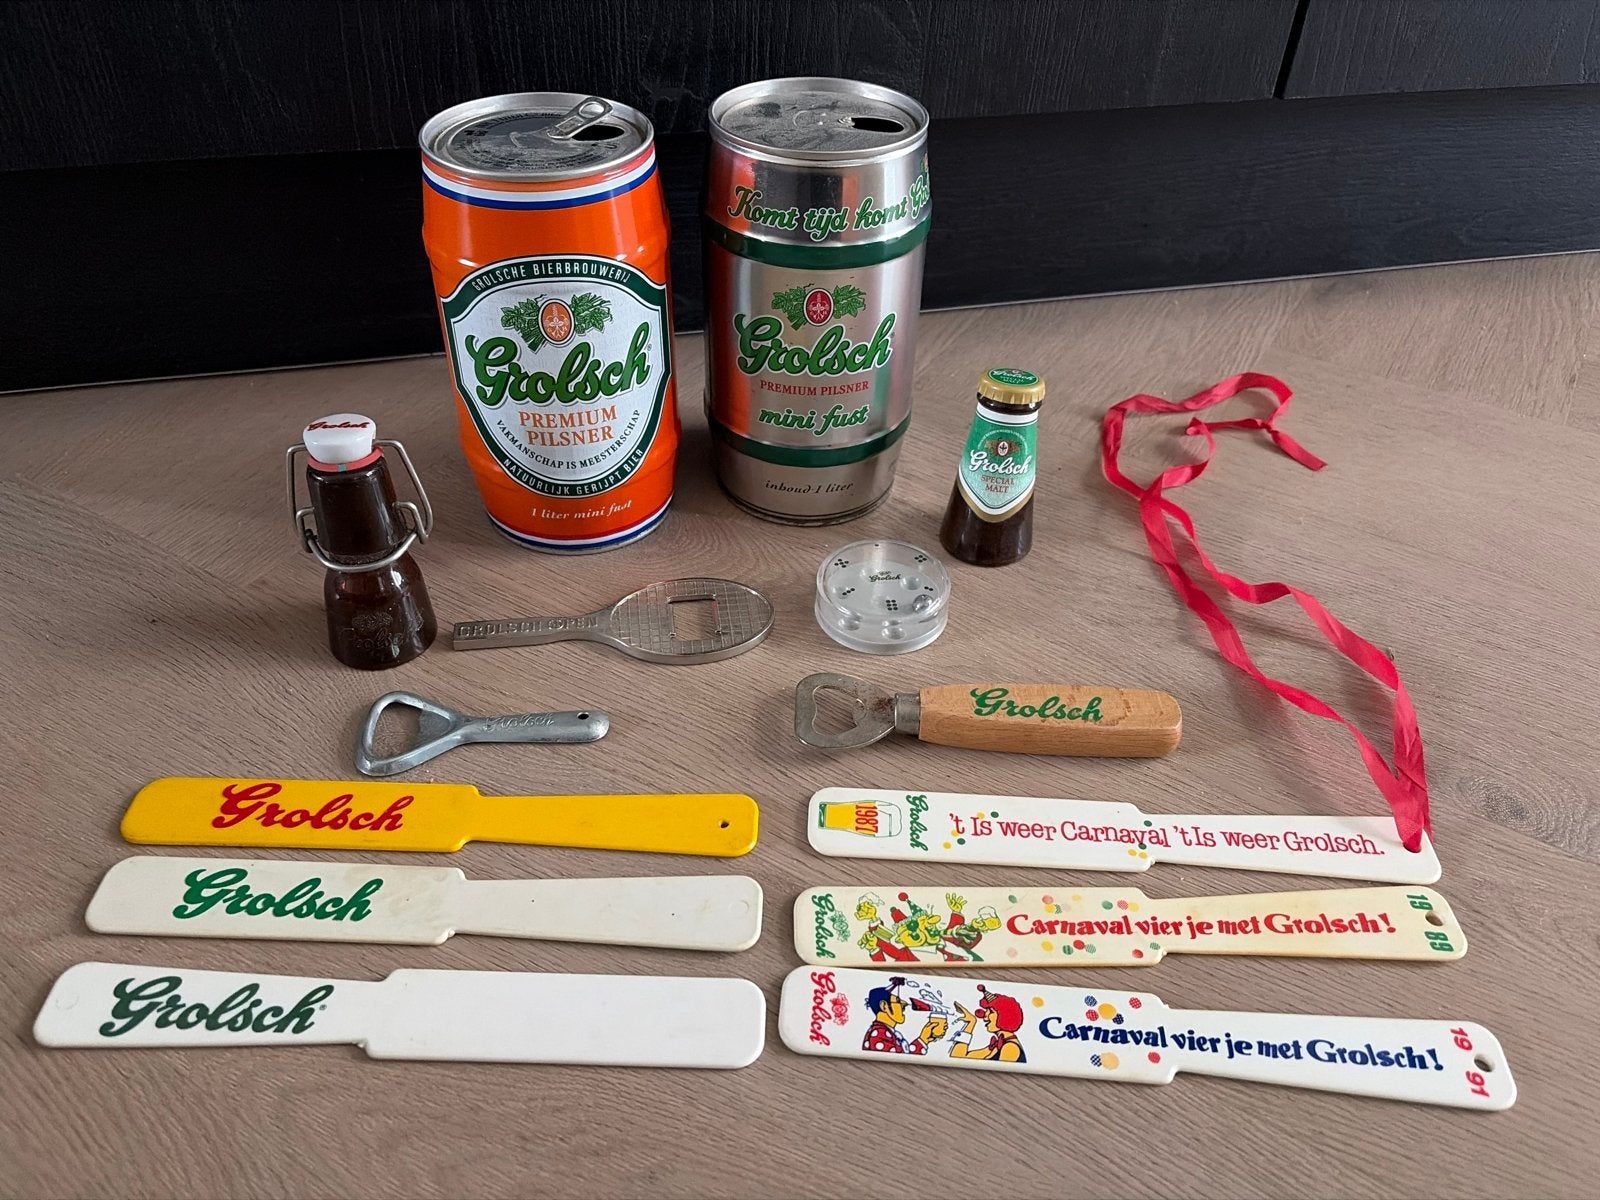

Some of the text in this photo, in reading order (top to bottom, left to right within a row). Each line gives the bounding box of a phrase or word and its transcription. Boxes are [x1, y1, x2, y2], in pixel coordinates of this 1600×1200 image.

[727, 185, 799, 230] Komt
[803, 207, 850, 241] tijd
[853, 197, 908, 231] komt
[472, 262, 631, 291] GROLSCHE BIERBROUWERIJ
[734, 312, 896, 376] Grolsch
[465, 321, 650, 406] Grolsch
[760, 379, 870, 396] PREMIUM PILSNER
[518, 405, 617, 429] PREMIUM
[758, 404, 870, 436] mini fust
[497, 409, 641, 470] VAKMANSCHAP IS MEESTERSCHAP
[527, 425, 614, 447] PILSNER
[503, 449, 643, 495] NATUURLIJK GERIJPT BIER
[969, 449, 1032, 475] Grolsch
[765, 480, 811, 493] inhoud
[825, 483, 853, 493] liter
[981, 475, 1014, 486] SPECIAL
[985, 484, 1010, 493] MALT
[532, 500, 633, 520] 1 liter mini fust
[869, 574, 902, 582] Grolsch
[548, 616, 599, 630] OPEN
[970, 687, 1103, 722] Grolsch
[211, 782, 414, 832] Grolsch
[855, 804, 878, 834] 1987
[906, 794, 929, 851] Grolsch
[970, 816, 992, 836] Is
[997, 820, 1057, 841] weer
[1060, 820, 1170, 848] Carnaval
[1220, 831, 1281, 851] weer
[1283, 831, 1385, 855] Grolsch.
[172, 868, 384, 922] Grolsch
[1406, 894, 1433, 911] 19
[812, 893, 836, 959] Grolsch
[1006, 912, 1397, 940] Carnaval vier je met Grolsch!
[1424, 931, 1454, 951] 89
[98, 976, 334, 1037] Grolsch
[808, 971, 836, 1047] Grolsch
[1039, 1017, 1444, 1071] Carnaval vier je met Grolsch!
[1450, 1027, 1473, 1050] 19
[1466, 1071, 1490, 1097] 91
